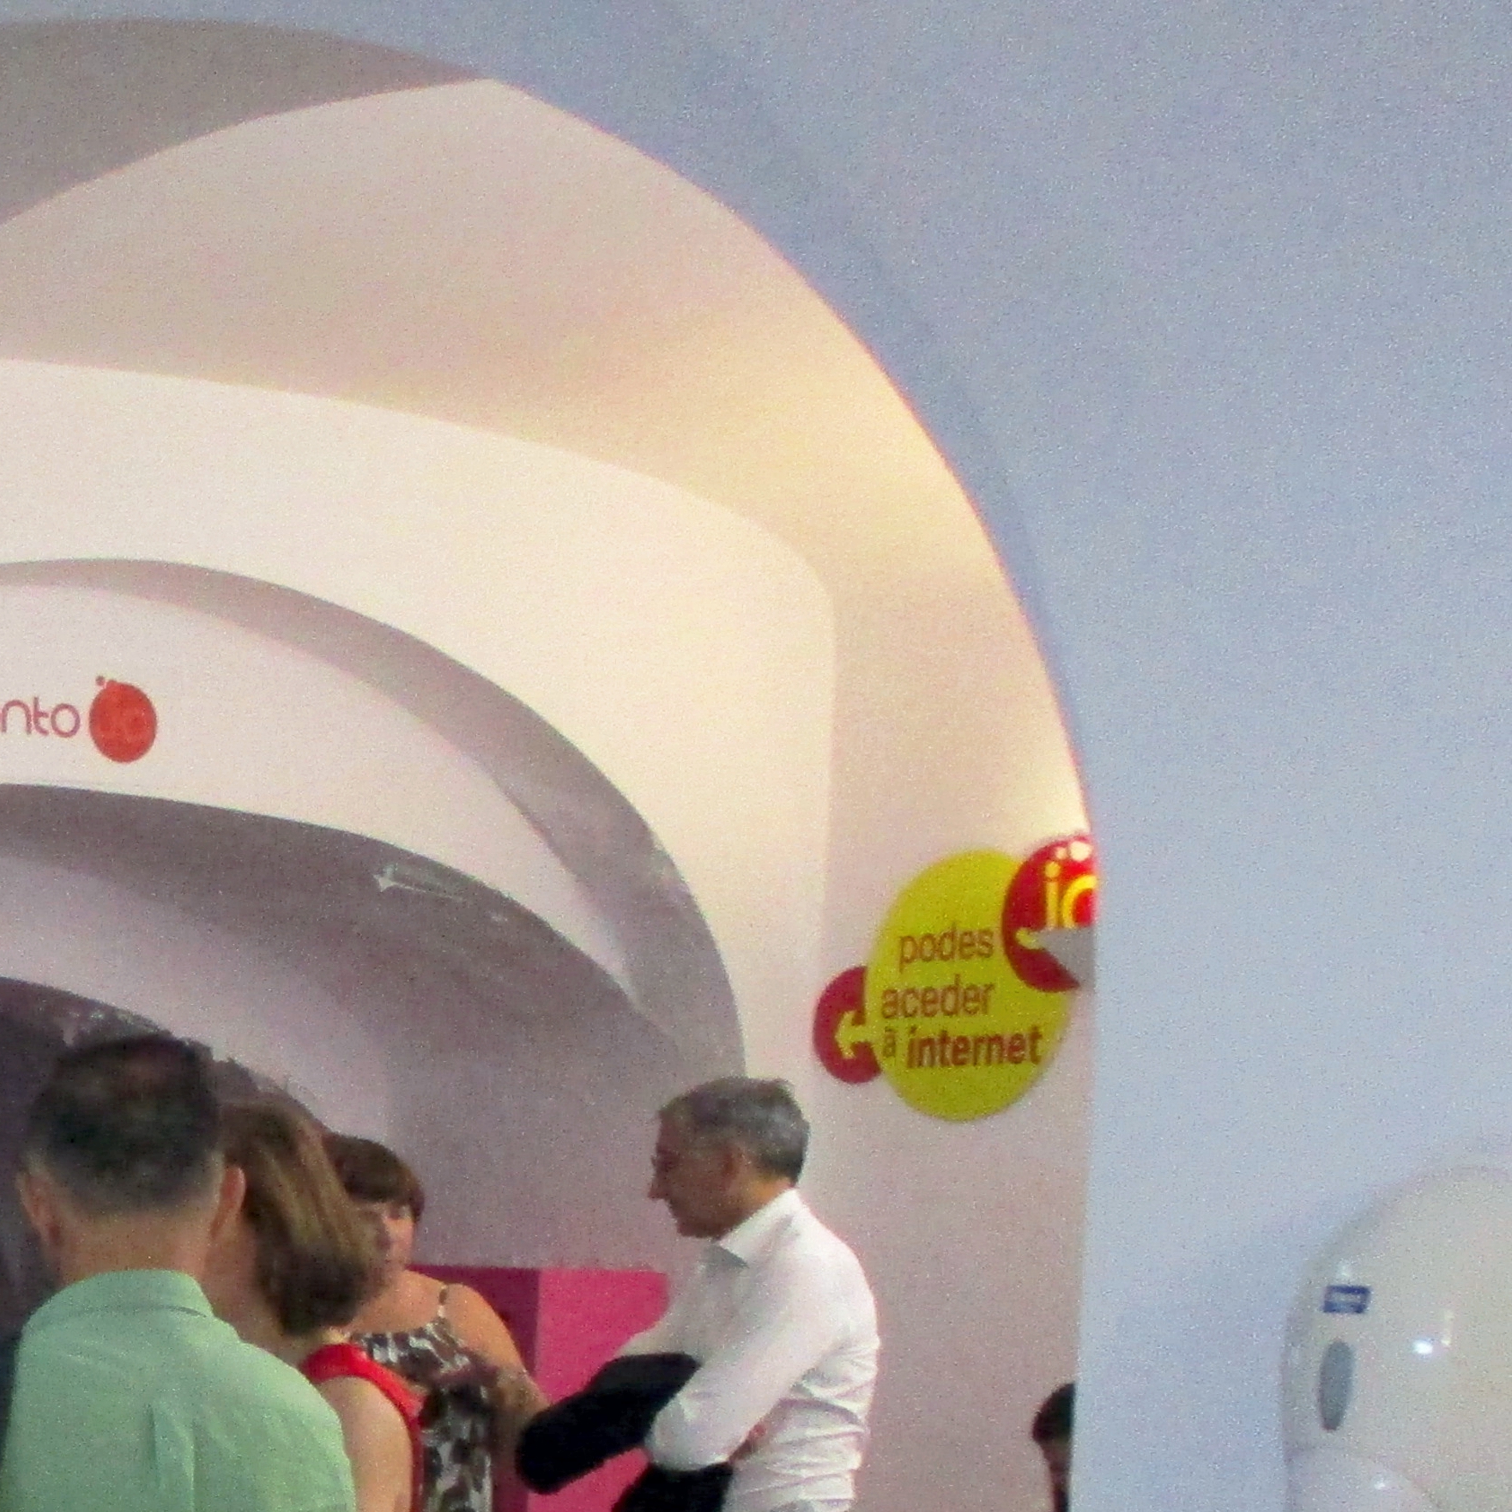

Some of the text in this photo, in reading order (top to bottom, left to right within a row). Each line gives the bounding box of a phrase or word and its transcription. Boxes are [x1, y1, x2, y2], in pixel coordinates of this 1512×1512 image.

[897, 921, 995, 974] podes
[880, 973, 996, 1019] aceder
[906, 1024, 1044, 1069] internet
